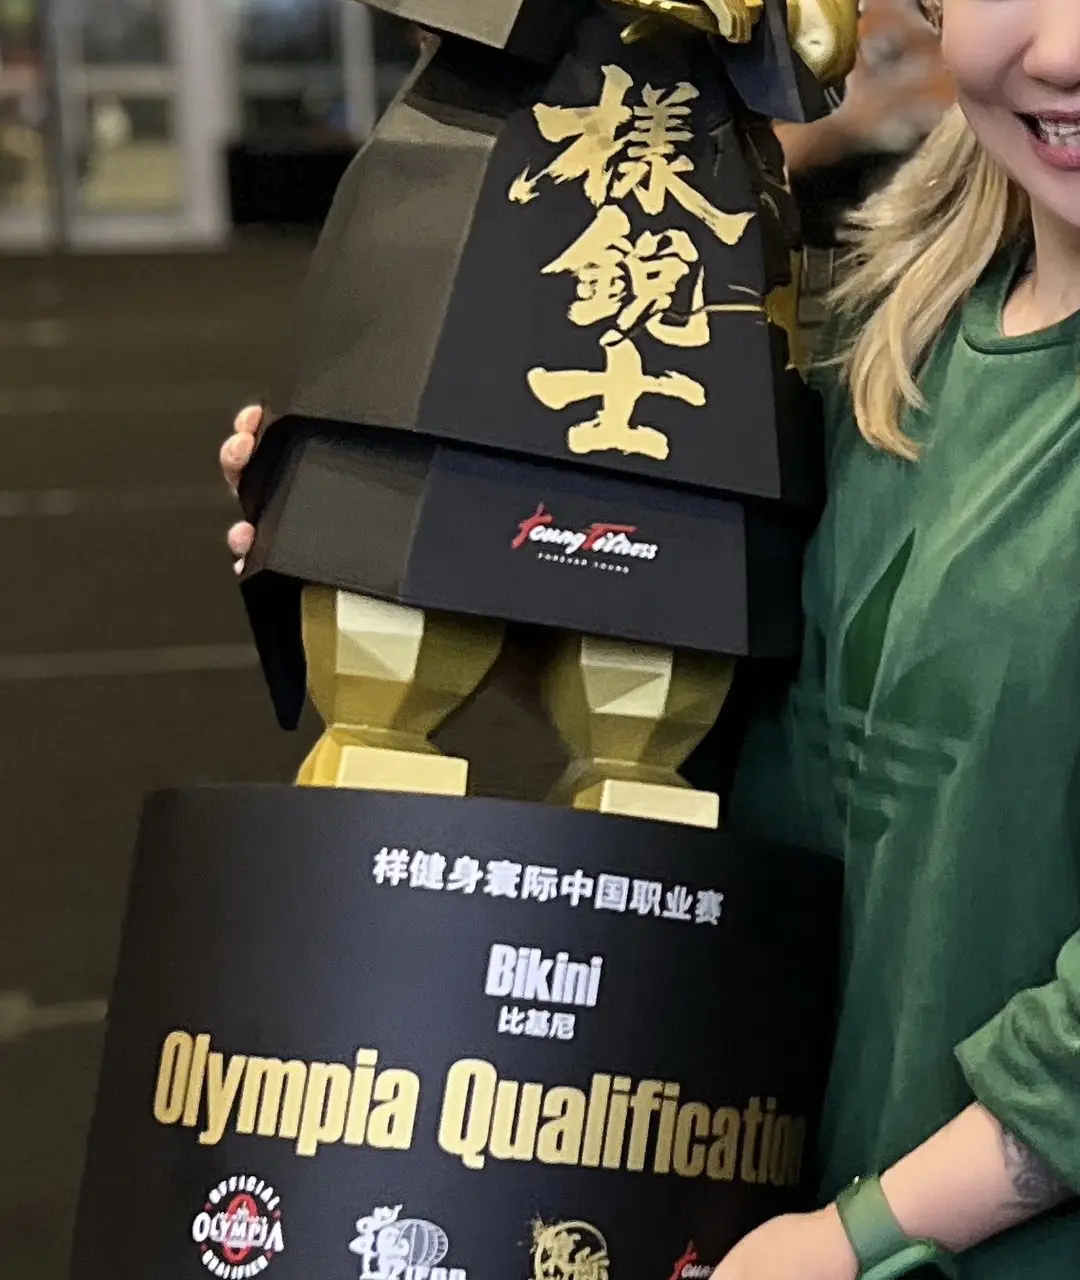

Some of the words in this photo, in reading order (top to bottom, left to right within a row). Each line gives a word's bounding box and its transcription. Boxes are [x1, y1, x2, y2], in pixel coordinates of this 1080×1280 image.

[485, 943, 603, 1007] Bikini
[498, 1005, 576, 1040] 比基尼
[153, 1030, 420, 1157] Olympia
